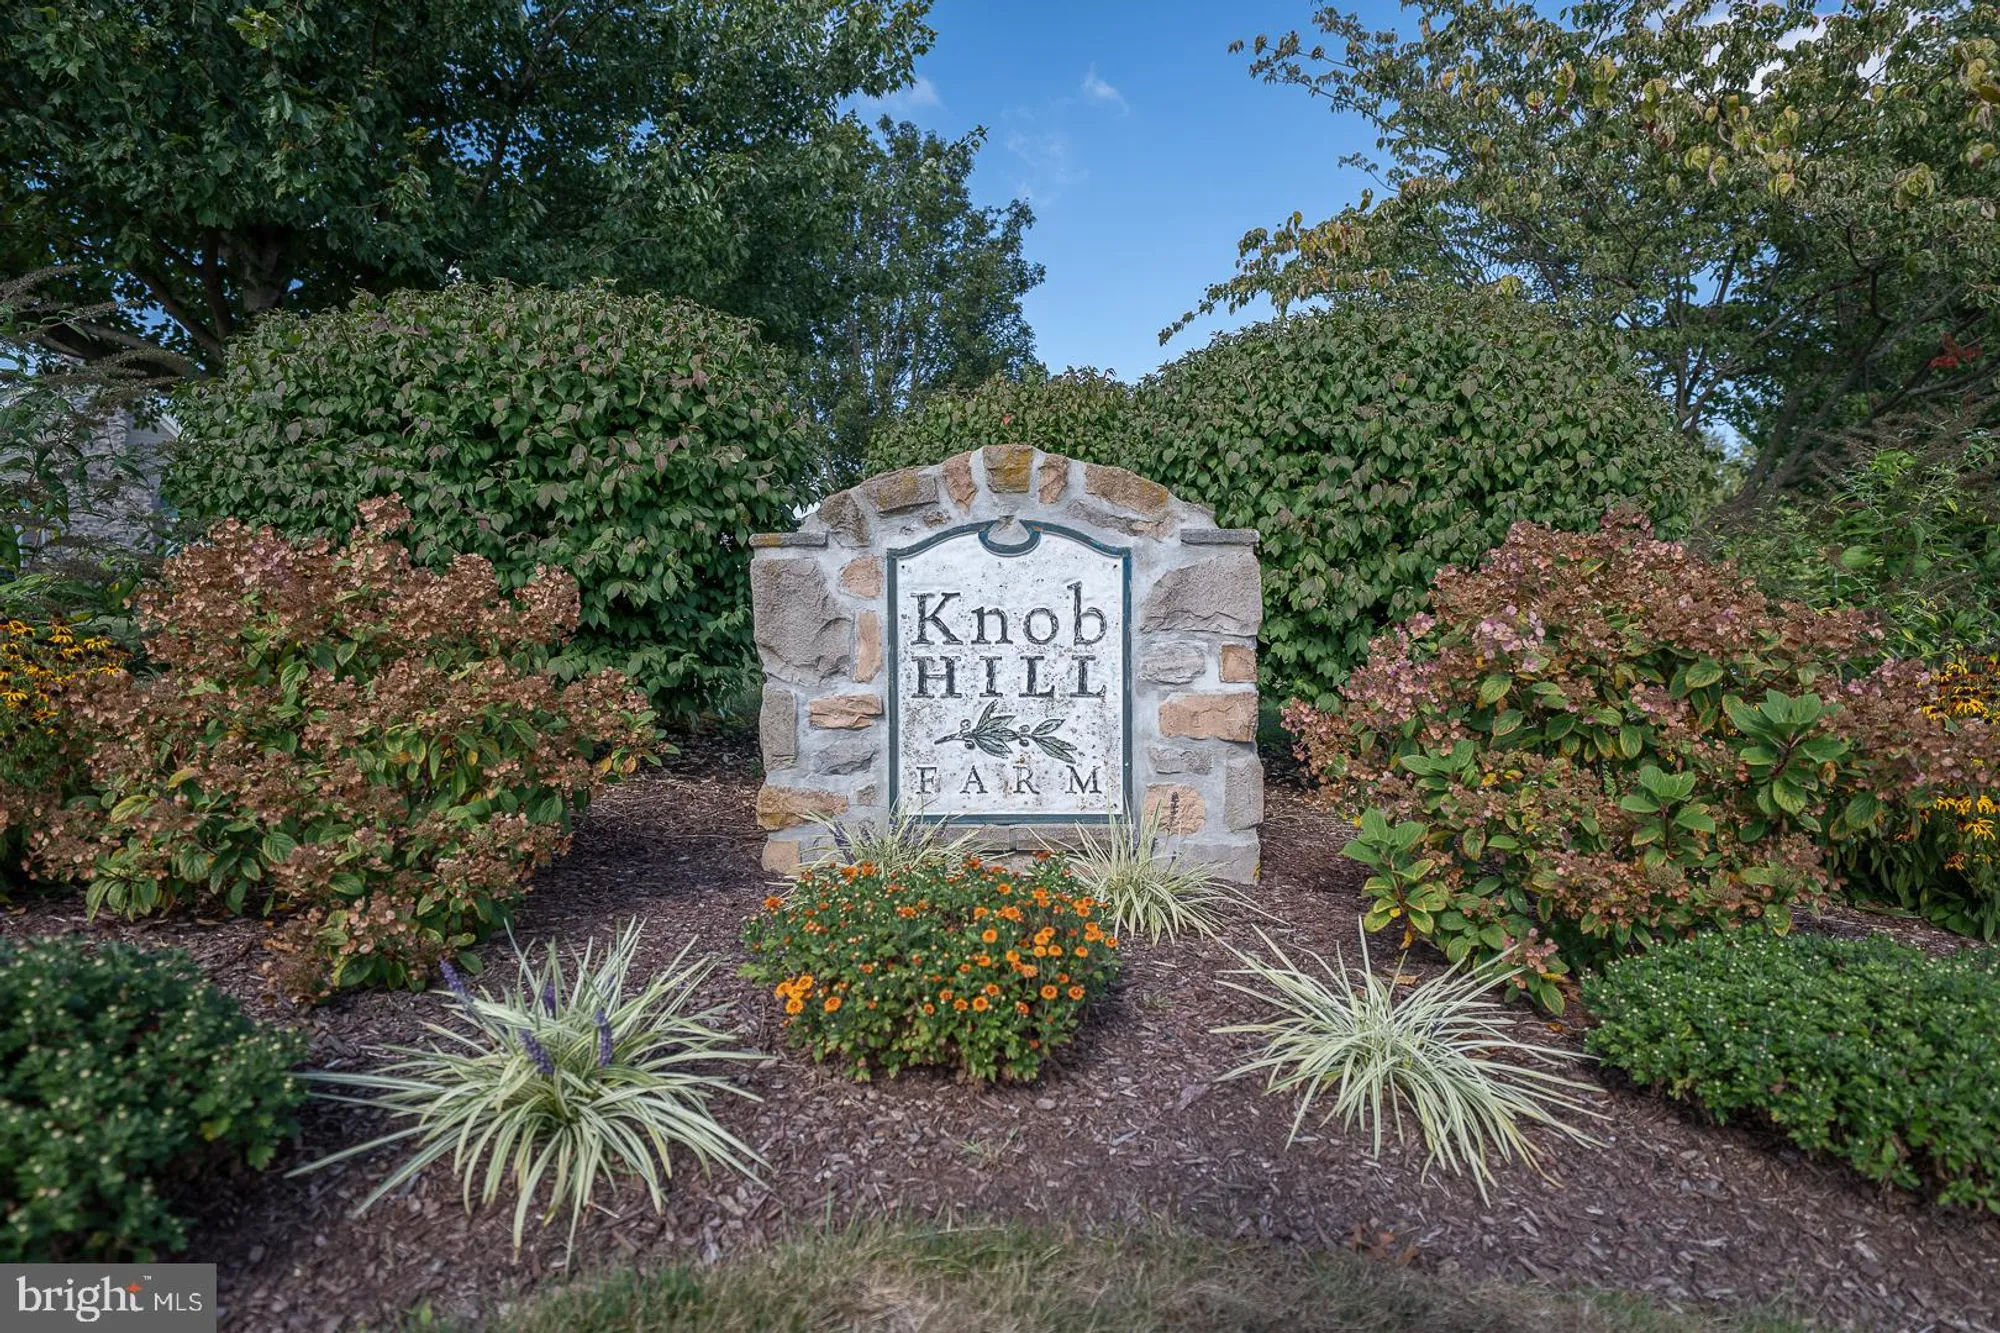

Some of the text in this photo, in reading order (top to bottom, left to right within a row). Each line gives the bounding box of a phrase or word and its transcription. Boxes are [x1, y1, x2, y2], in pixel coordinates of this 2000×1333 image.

[910, 581, 1107, 646] Knob
[911, 655, 1106, 699] HILL
[916, 765, 1102, 794] FARM
